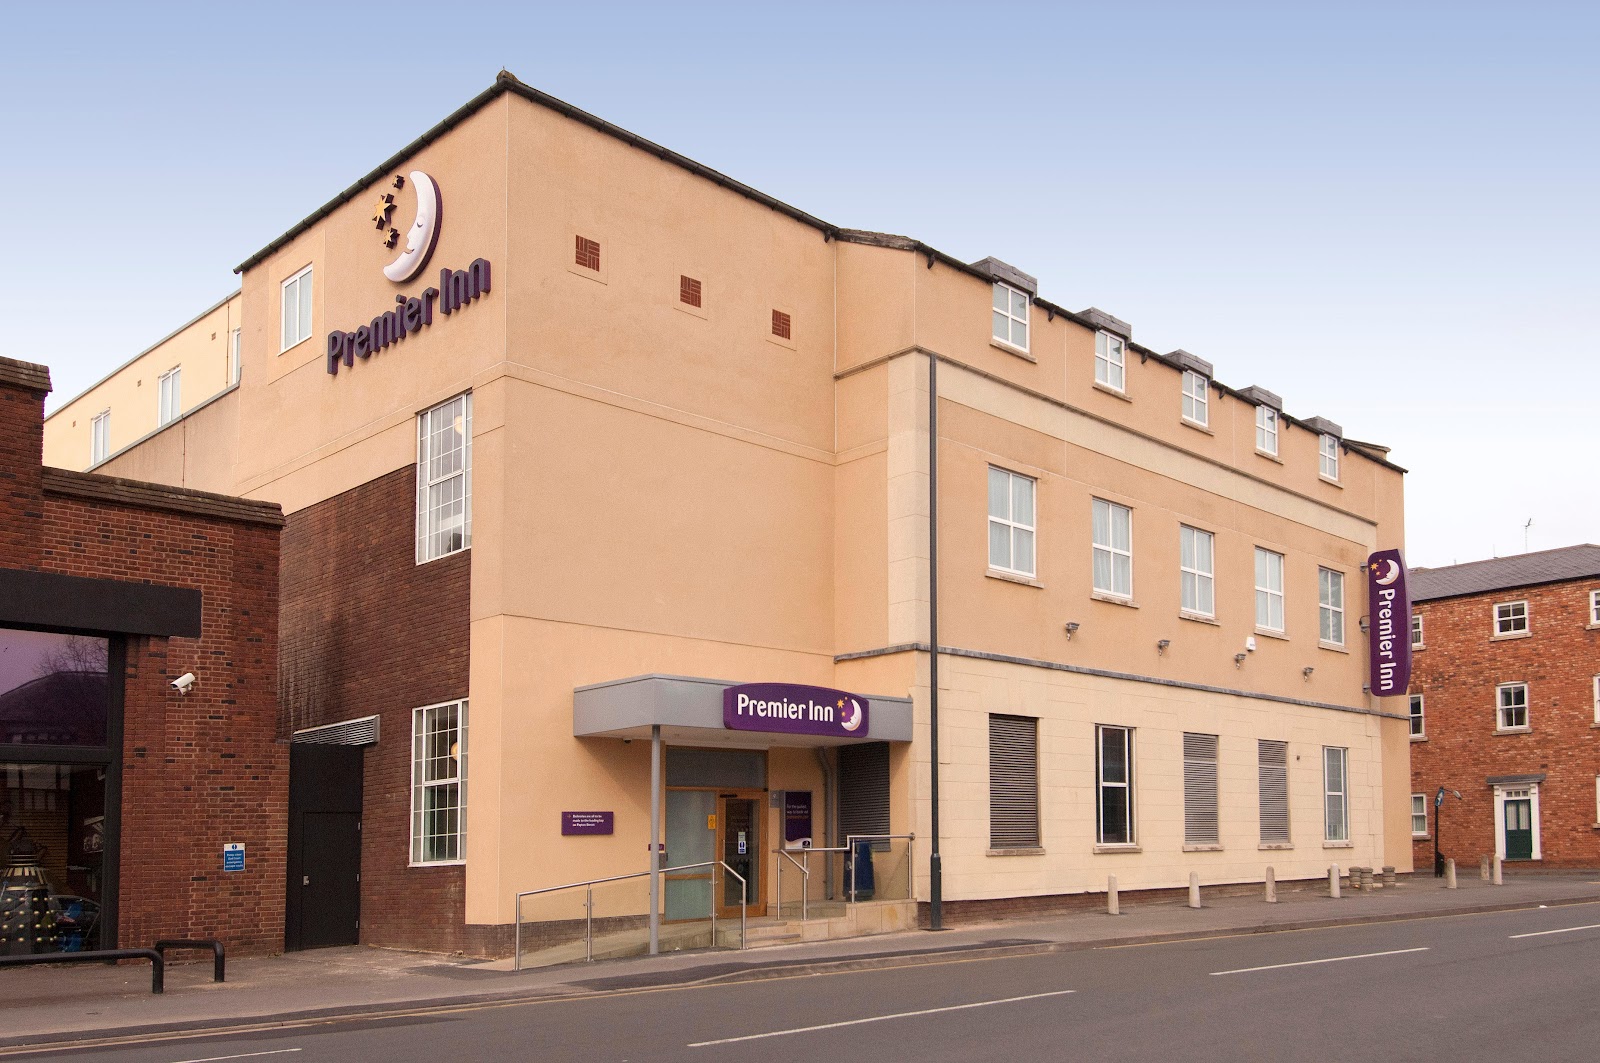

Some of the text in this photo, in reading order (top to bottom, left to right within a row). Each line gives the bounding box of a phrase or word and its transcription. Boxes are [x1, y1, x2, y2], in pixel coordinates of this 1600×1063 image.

[327, 257, 491, 375] Premier Inn
[1378, 588, 1397, 691] Premier Inn
[737, 693, 834, 722] Premier Inn
